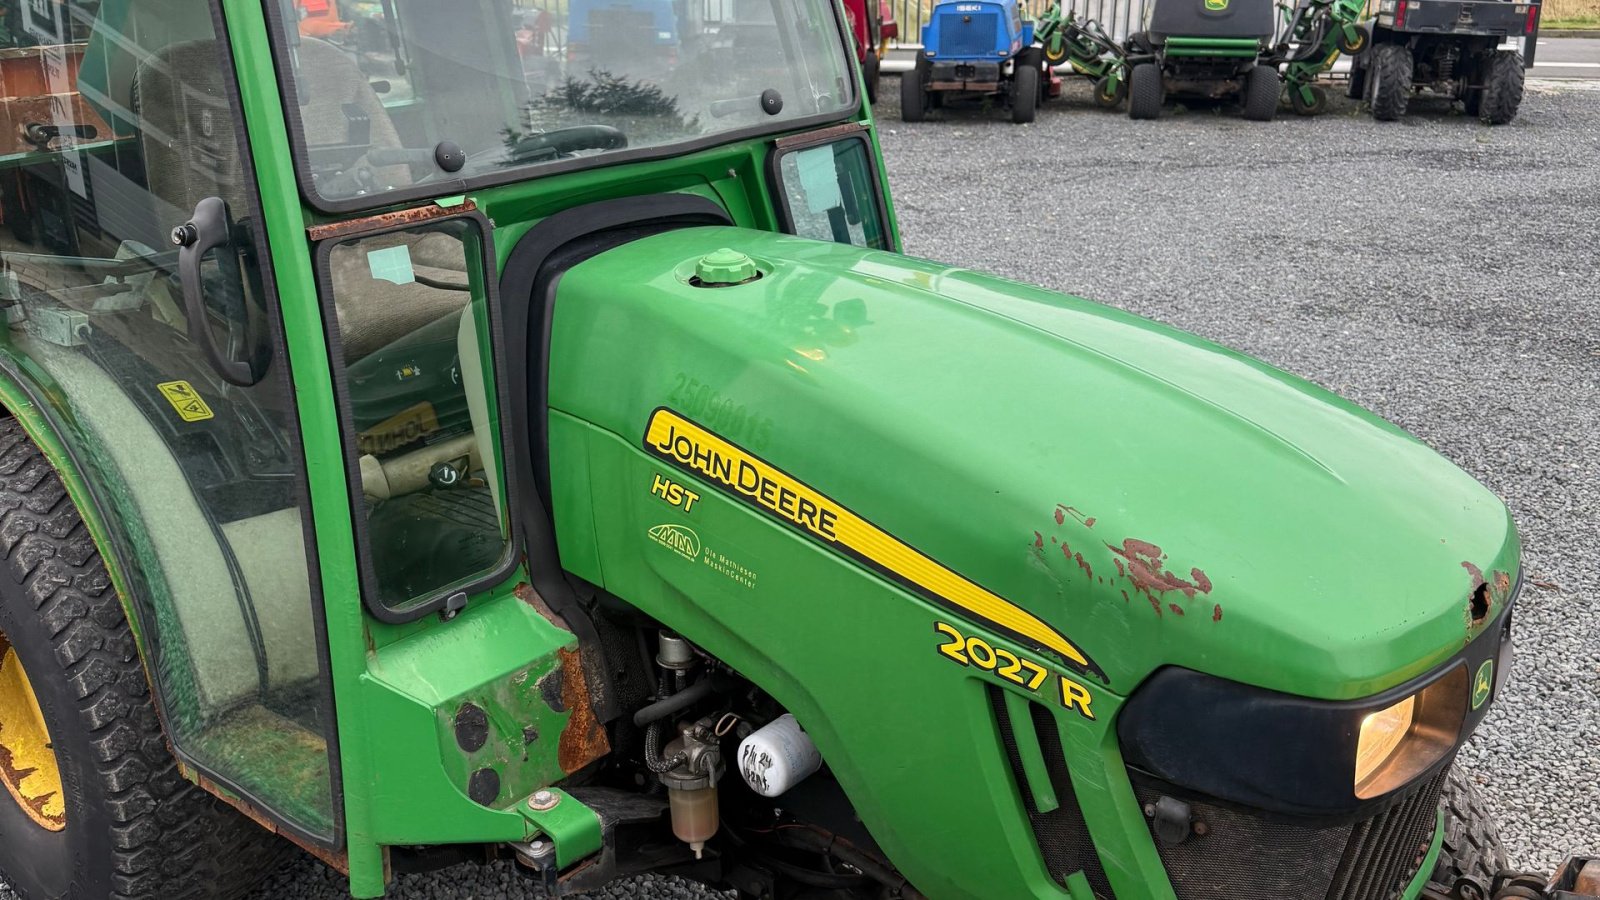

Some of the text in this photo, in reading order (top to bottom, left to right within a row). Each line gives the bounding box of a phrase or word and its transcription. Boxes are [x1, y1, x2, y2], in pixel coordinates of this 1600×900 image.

[652, 475, 700, 513] HST
[659, 426, 838, 539] JOHN DEERE
[704, 547, 716, 559] Ole
[719, 555, 757, 579] Mathiesen
[704, 557, 756, 589] MaskinCenter
[934, 621, 1096, 721] 2027 R
[759, 752, 774, 769] 24
